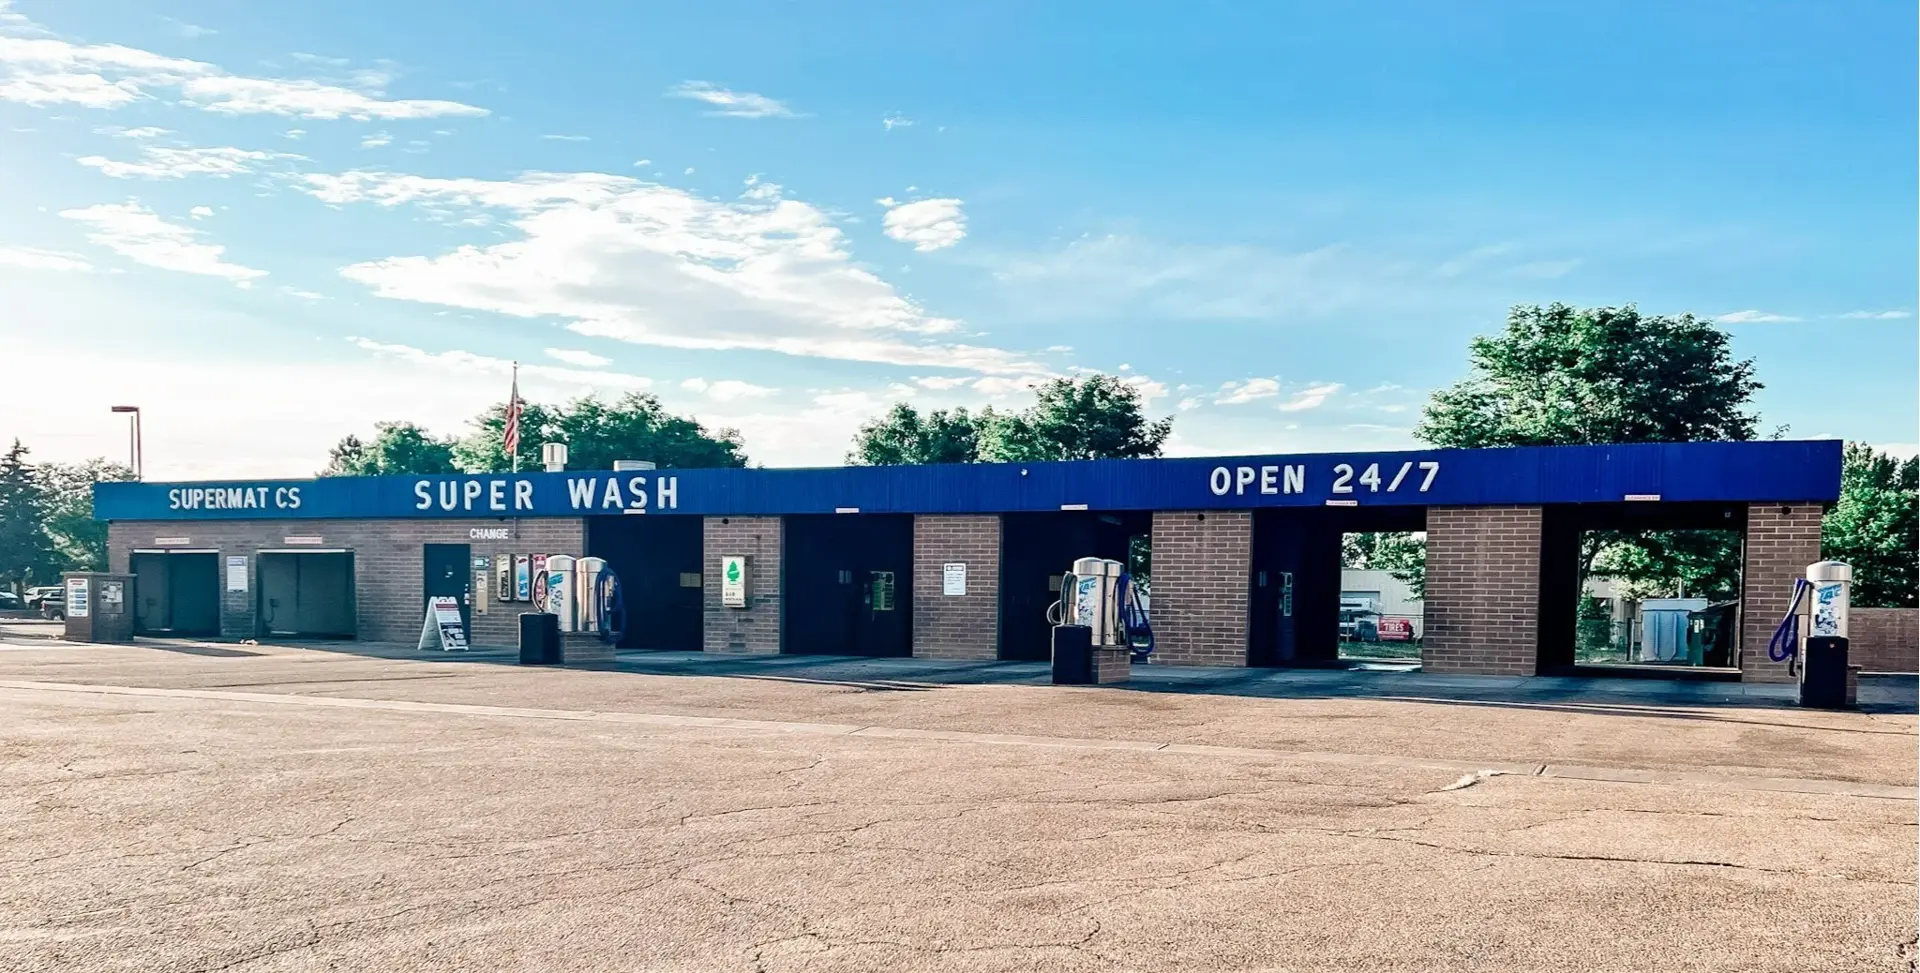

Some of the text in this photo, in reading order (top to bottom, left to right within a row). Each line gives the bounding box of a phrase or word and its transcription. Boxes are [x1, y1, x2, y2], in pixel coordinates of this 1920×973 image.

[1210, 462, 1440, 495] OPEN 24/7
[414, 477, 678, 511] SUPER WASH
[470, 528, 509, 540] CHANGE
[1383, 623, 1404, 632] TIRES
